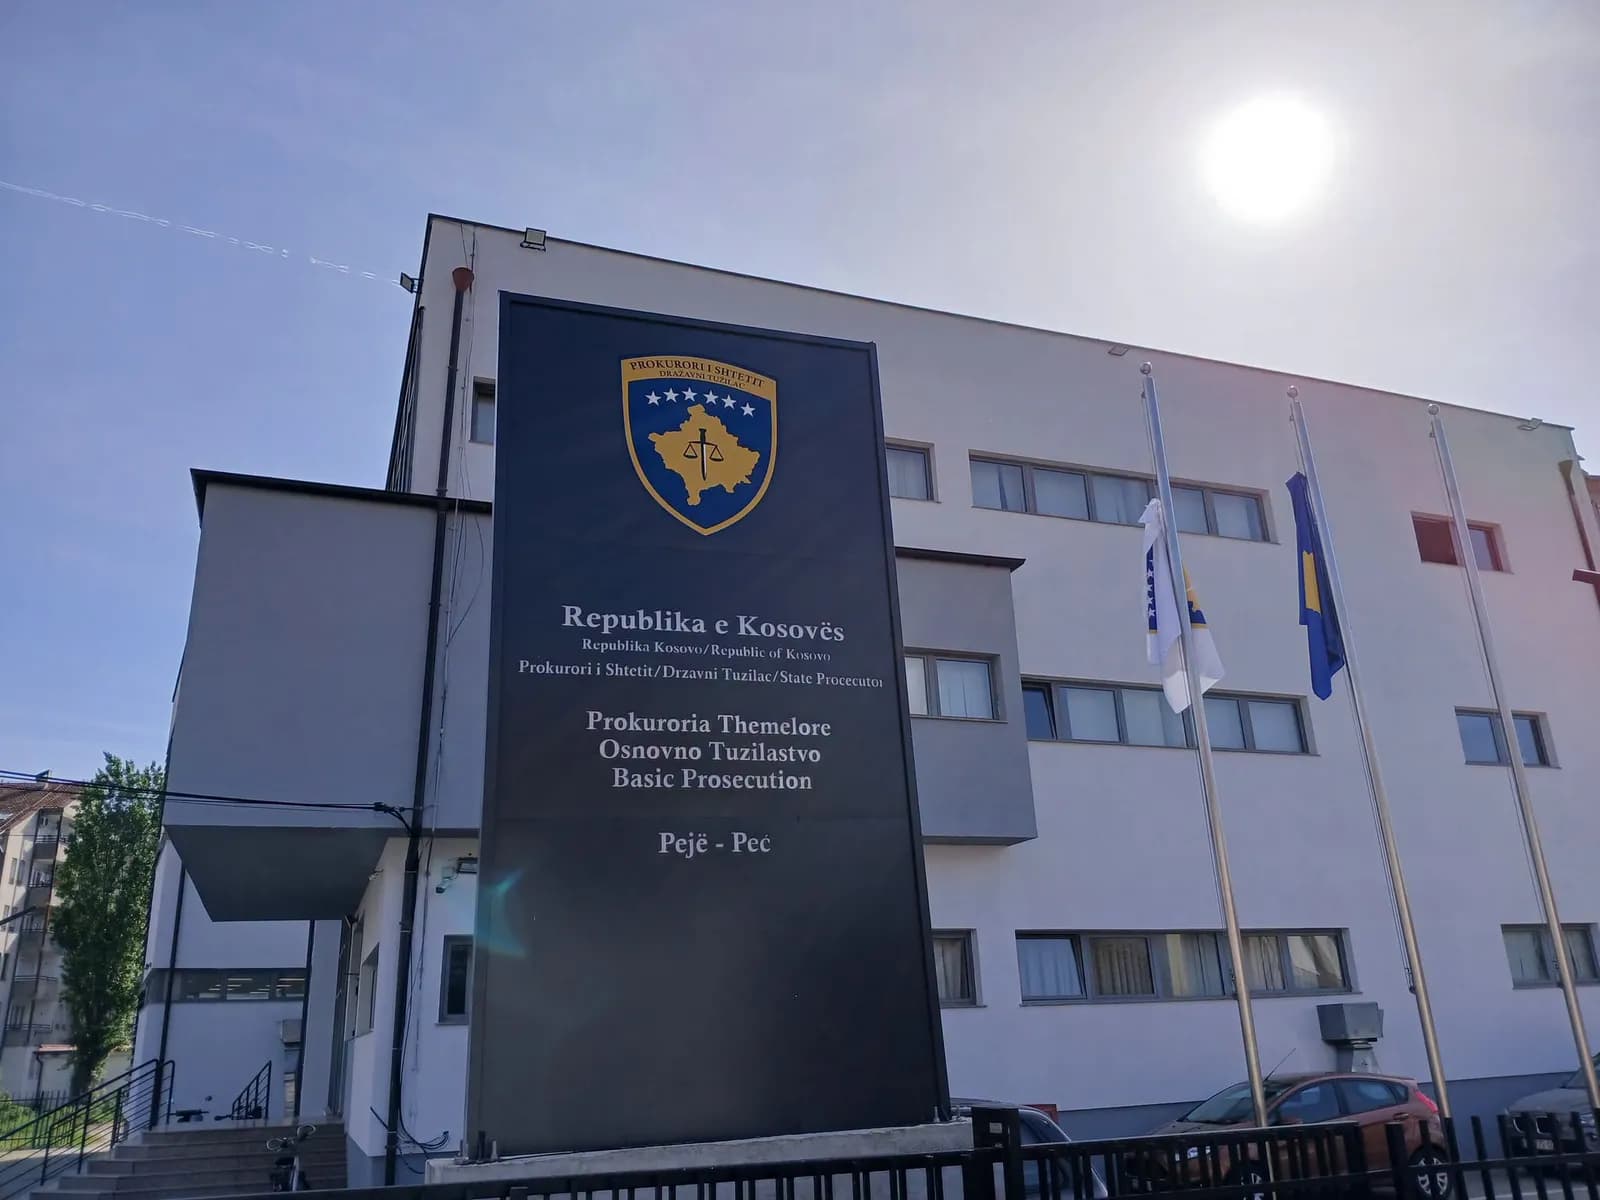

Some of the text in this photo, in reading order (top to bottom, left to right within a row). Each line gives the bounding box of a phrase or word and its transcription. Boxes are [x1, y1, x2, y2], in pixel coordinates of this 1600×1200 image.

[630, 359, 765, 389] PROKURORI I SHTETIT
[562, 604, 845, 642] Republika e Kosovës
[582, 638, 832, 662] Republika Kosovo/Republic of Kosovo
[518, 659, 592, 675] Prokurori
[596, 663, 601, 676] i
[605, 662, 717, 681] Shtetit/Drzavni
[721, 667, 813, 685] Tuzilac/State
[586, 710, 831, 736] Prokuroria Themelore
[599, 738, 821, 763] Osnovno Tuzilastvo
[612, 767, 813, 790] Basic Prosecution
[658, 831, 708, 859] Pejë
[731, 831, 771, 853] Peć
